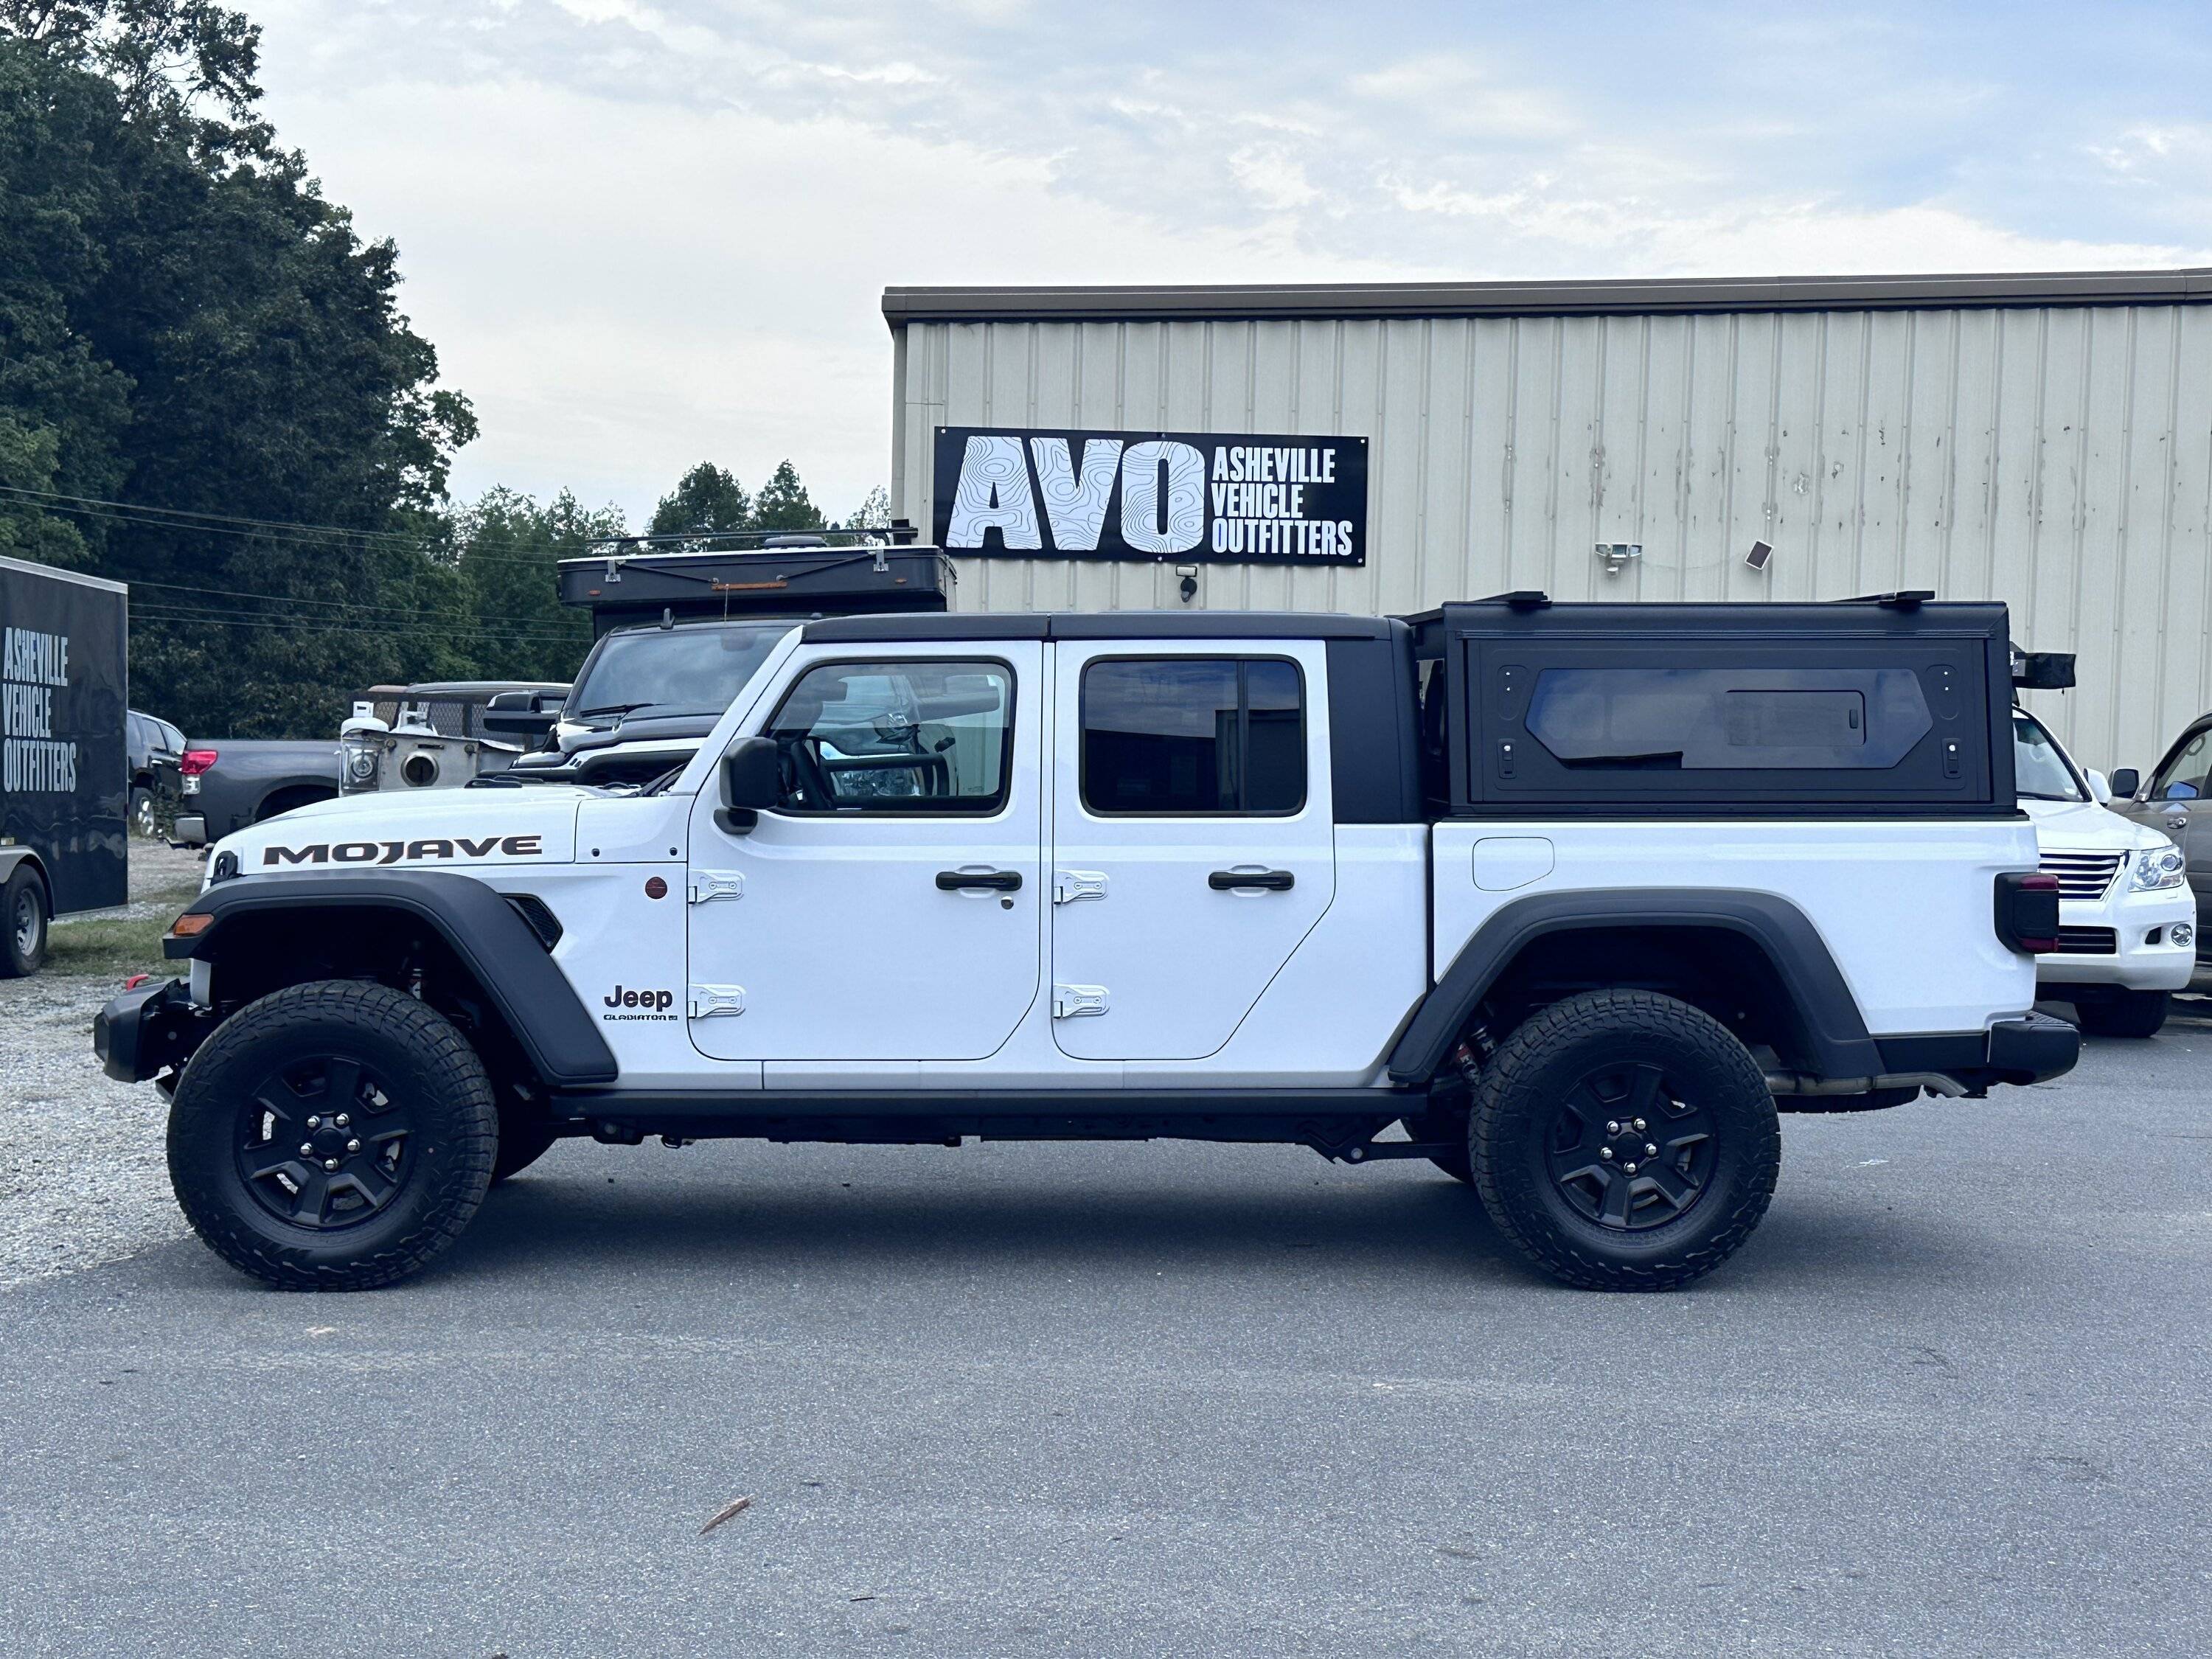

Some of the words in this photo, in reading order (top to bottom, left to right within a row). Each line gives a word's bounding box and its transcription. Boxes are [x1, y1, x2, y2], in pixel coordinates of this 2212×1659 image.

[1211, 446, 1335, 483] ASHEVILLE
[946, 436, 1206, 554] AVO
[1211, 482, 1304, 518] VEHICLE
[1211, 518, 1353, 556] OUTFITTERS
[3, 627, 69, 686] ASHEVILLE
[2, 683, 52, 738] VEHICLE
[3, 738, 77, 793] OUTFITTERS
[262, 835, 542, 865] MOJAVE
[604, 985, 673, 1012] Jeep
